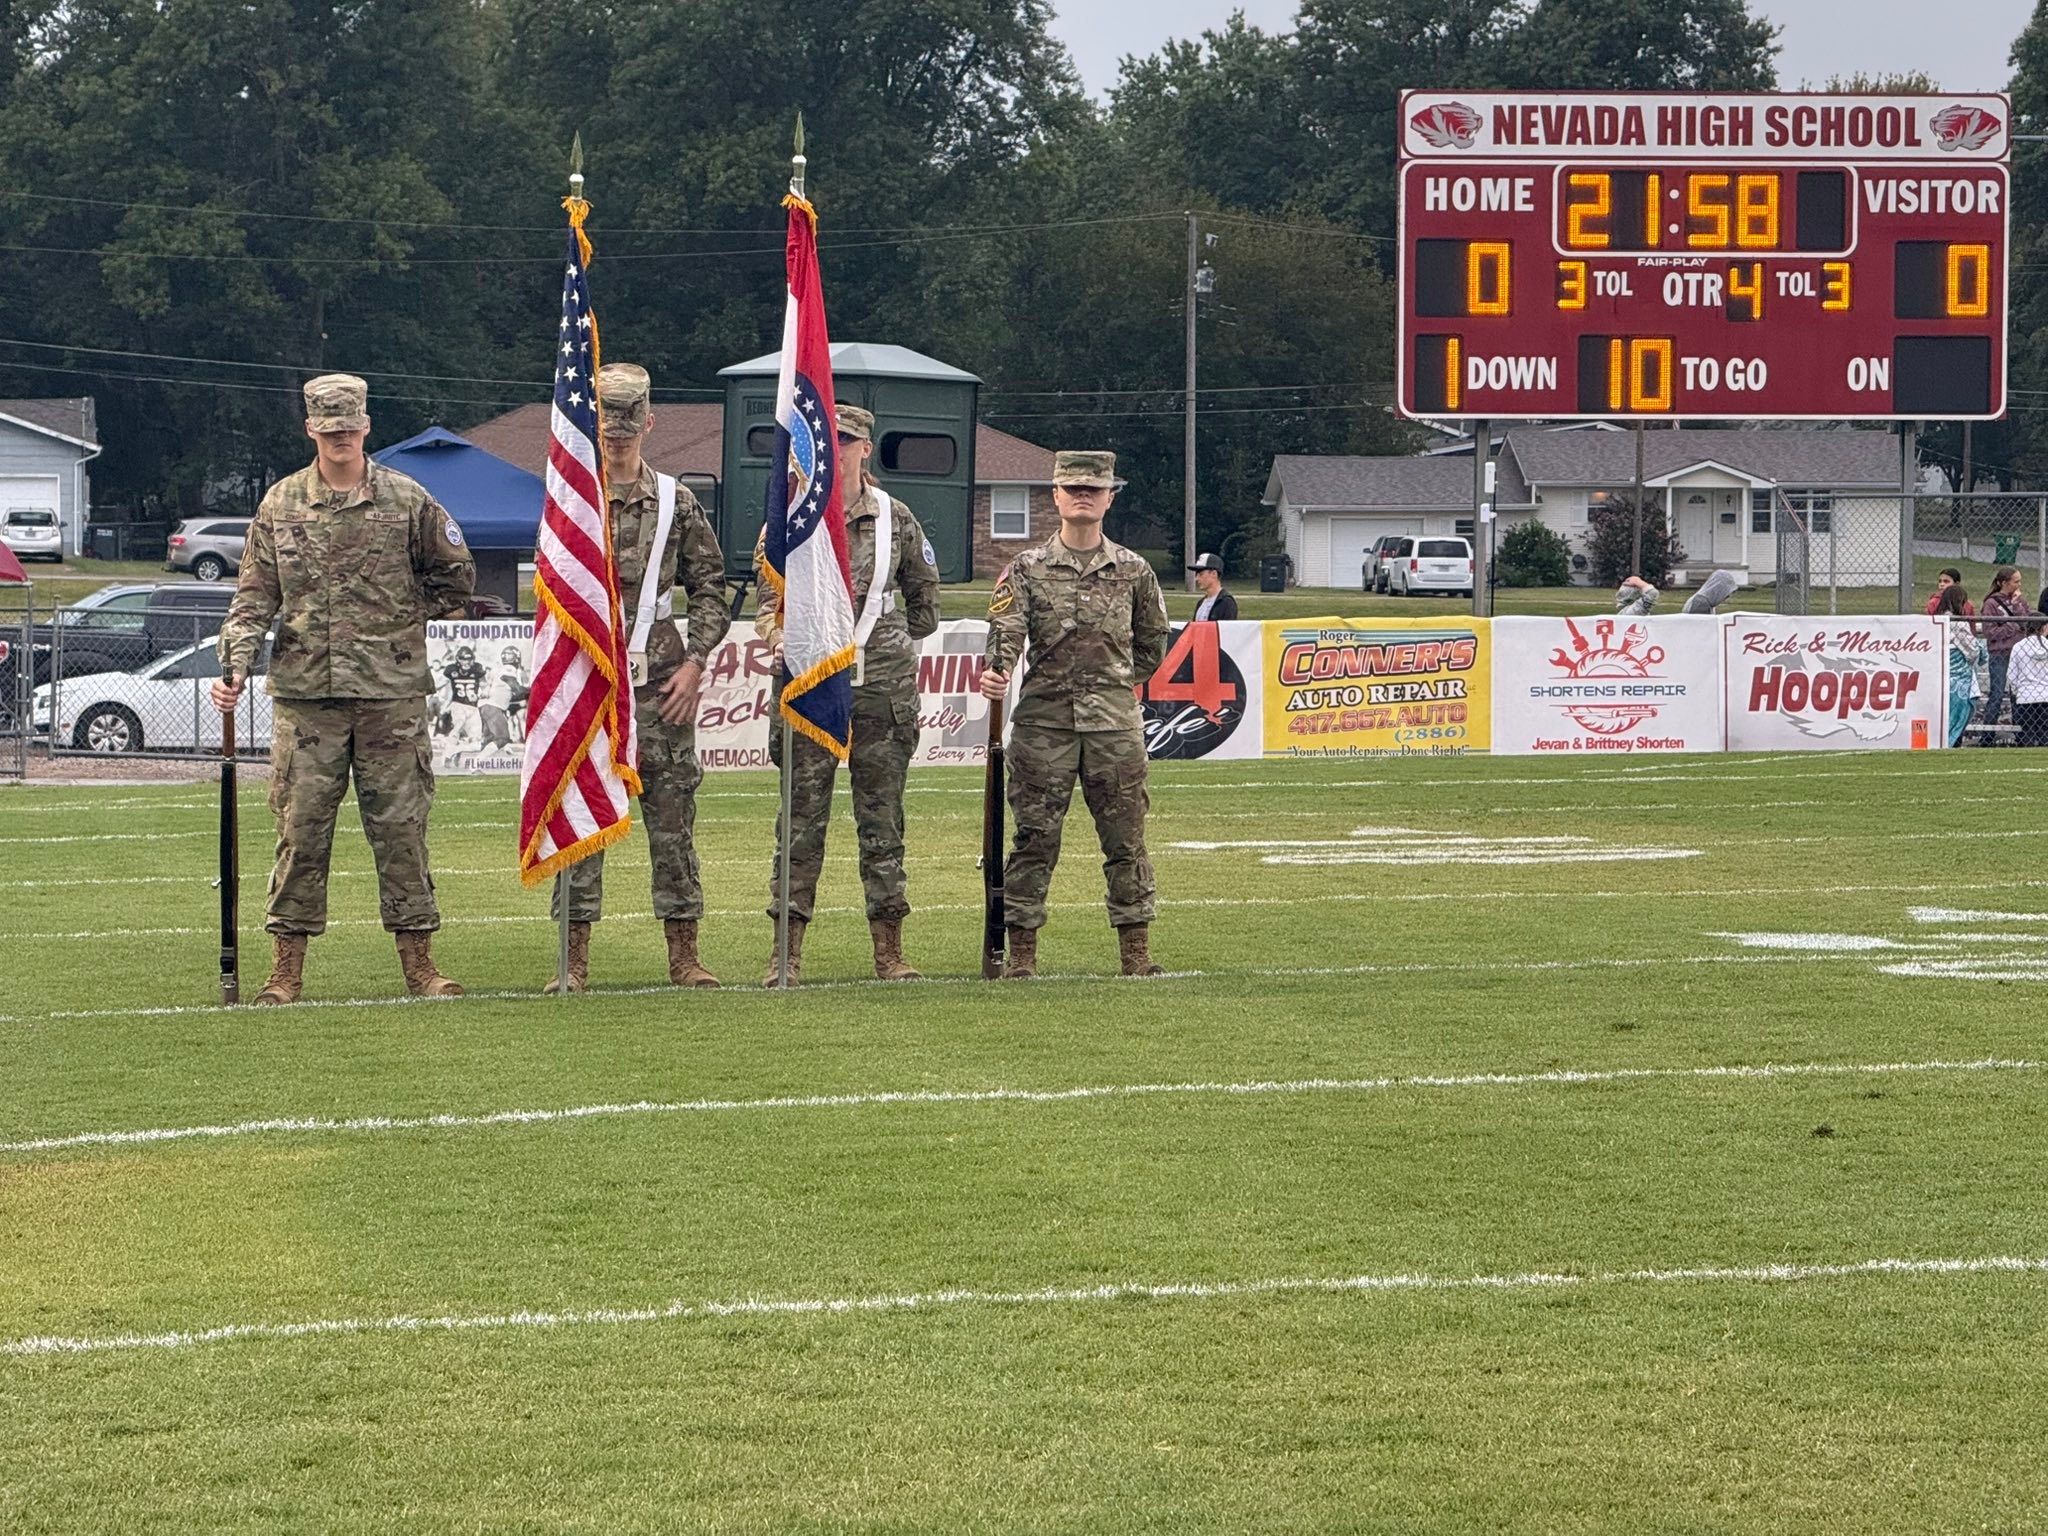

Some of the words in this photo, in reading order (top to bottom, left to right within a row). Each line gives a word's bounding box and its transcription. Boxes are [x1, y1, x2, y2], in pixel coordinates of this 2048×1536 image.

[1493, 104, 1646, 147] NEVADA
[1656, 104, 1754, 147] HIGH
[1765, 105, 1922, 148] SCHOOL
[1425, 177, 1535, 212] HOME
[1567, 172, 1780, 248] 21:58
[1864, 178, 2000, 214] VISITOR
[1467, 241, 1510, 315] 0
[1637, 257, 1708, 267] FAIR-PLAY
[1557, 261, 1586, 310] 3
[1594, 270, 1634, 297] TOL
[1662, 271, 1724, 307] QTR
[1728, 263, 1763, 321] 4
[1776, 271, 1816, 298] TOL
[1821, 261, 1851, 311] 3
[1947, 243, 1990, 316] 0
[1446, 337, 1460, 410] 1
[1467, 357, 1557, 391] DOWN
[1609, 337, 1672, 411] 10
[1682, 358, 1720, 391] TO
[1725, 358, 1768, 392] GO
[1847, 357, 1889, 391] ON
[428, 624, 448, 639] ON
[453, 624, 533, 640] FOUNDATIO
[1319, 629, 1356, 645] Roger
[1742, 632, 1801, 656] Rick
[1805, 632, 1827, 653] &
[1837, 631, 1932, 653] Marsha
[1133, 620, 1236, 724] 4
[1279, 637, 1477, 686] CONNER'S
[1286, 683, 1364, 711] AUTO
[1368, 677, 1467, 705] REPAIR
[1530, 685, 1617, 698] SHORTENS
[1621, 684, 1687, 697] REPAIR
[1748, 666, 1919, 719] Hooper
[695, 689, 770, 728] ack
[1288, 702, 1467, 735] 417.667.AUTO
[1322, 745, 1347, 757] Auto
[1401, 744, 1428, 757] Done
[1394, 725, 1466, 743] (2886)
[1531, 737, 1570, 751] Jevan
[1572, 737, 1583, 751] &
[1585, 736, 1634, 753] Brittney
[1636, 736, 1685, 751] Shorten
[927, 745, 966, 762] Every
